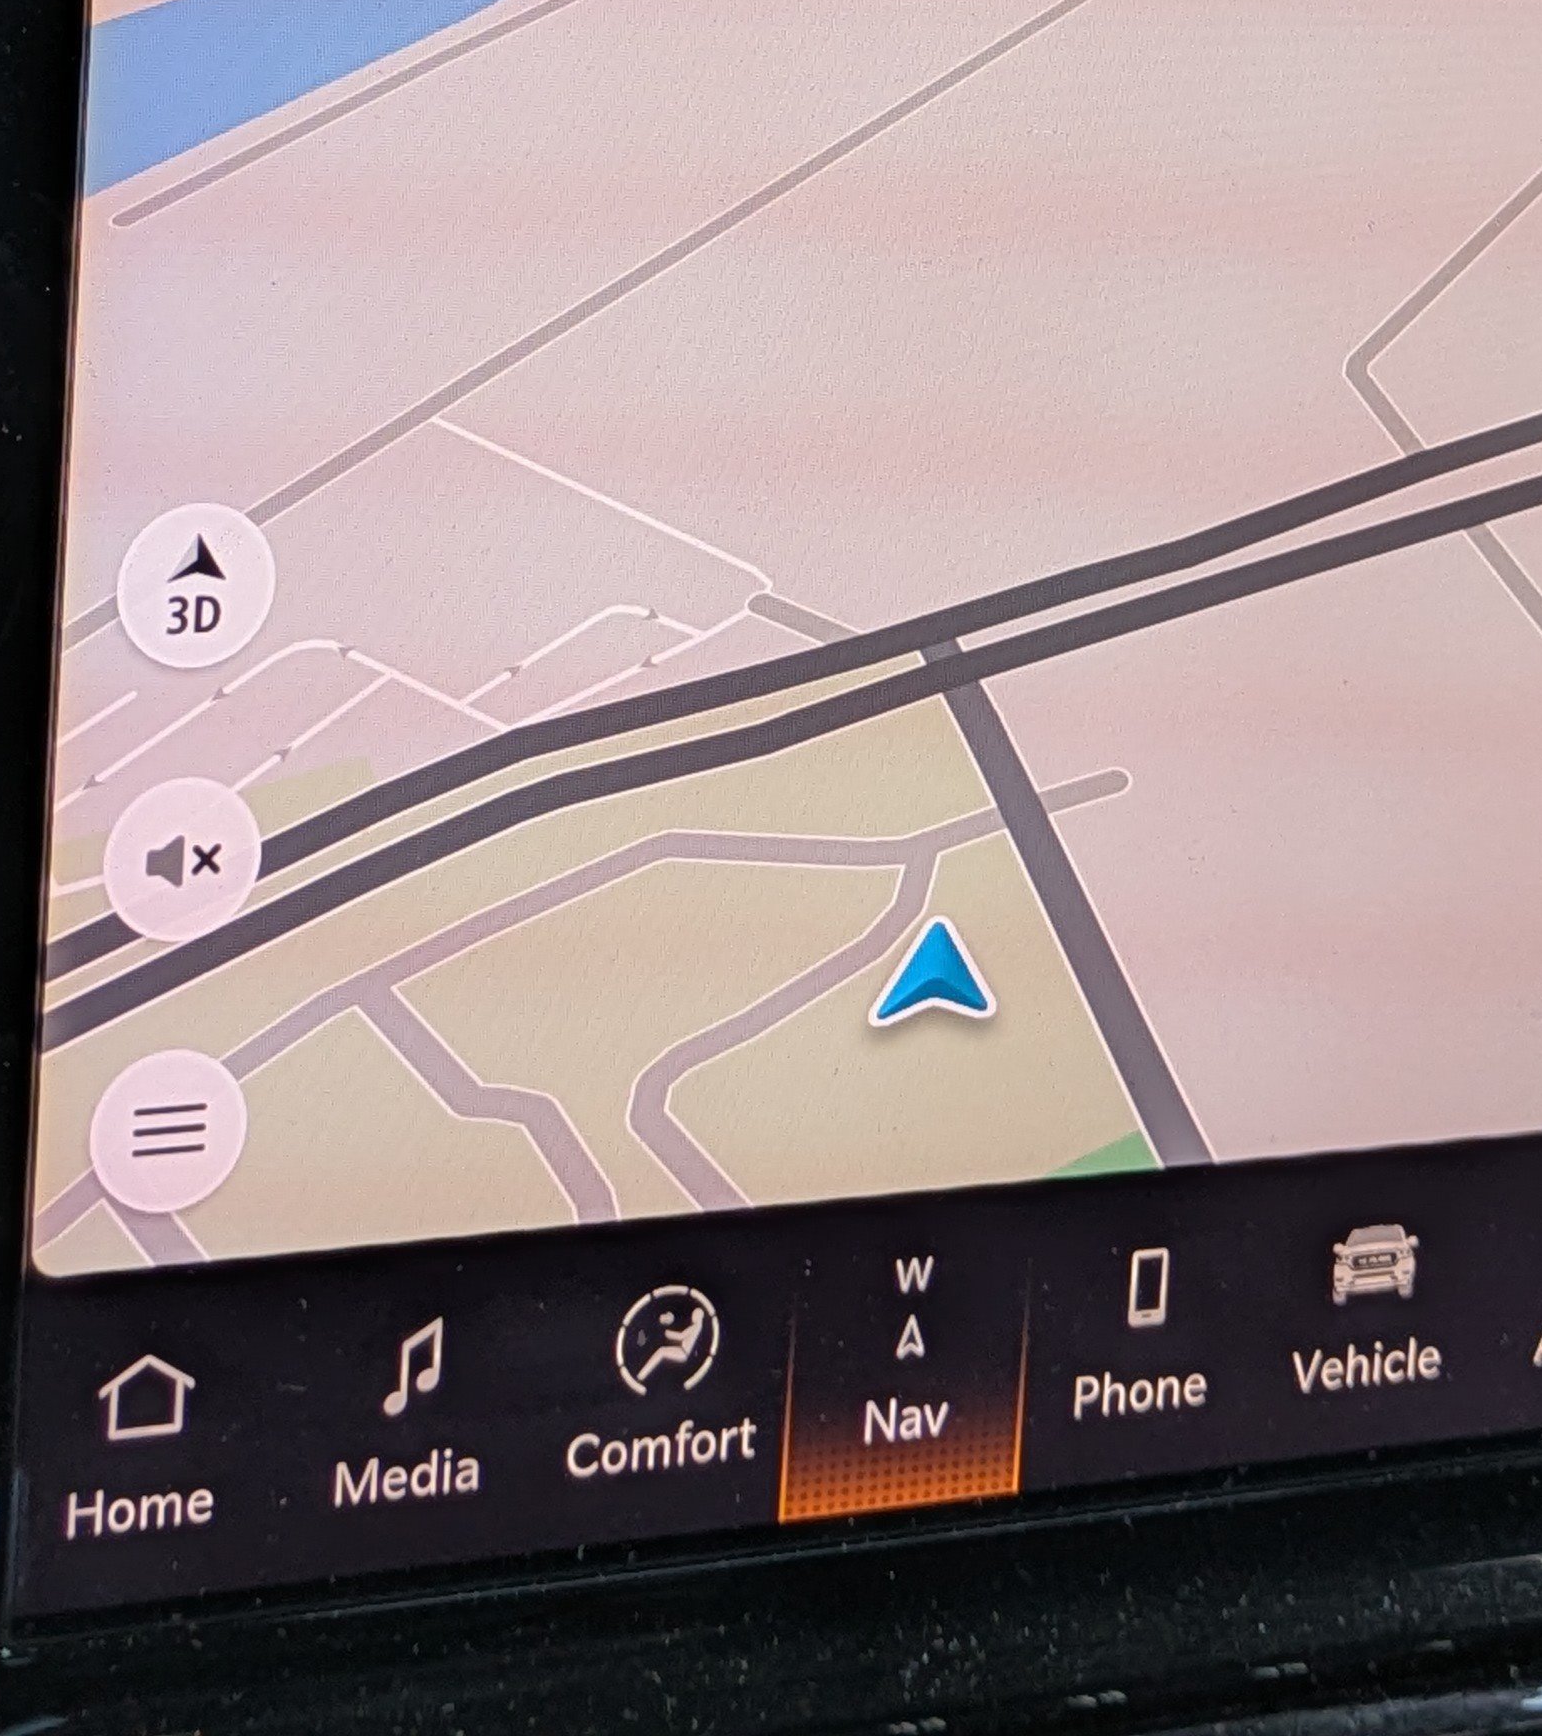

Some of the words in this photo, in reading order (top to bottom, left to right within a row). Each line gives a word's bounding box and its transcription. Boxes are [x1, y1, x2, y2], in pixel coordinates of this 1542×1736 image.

[166, 595, 221, 635] 3D
[895, 1255, 934, 1294] W
[1293, 1337, 1442, 1394] Vehicle
[1073, 1367, 1208, 1420] Phone
[566, 1416, 758, 1479] Comfort
[863, 1398, 950, 1446] Nav
[333, 1447, 480, 1508] Media
[65, 1486, 215, 1541] Home
